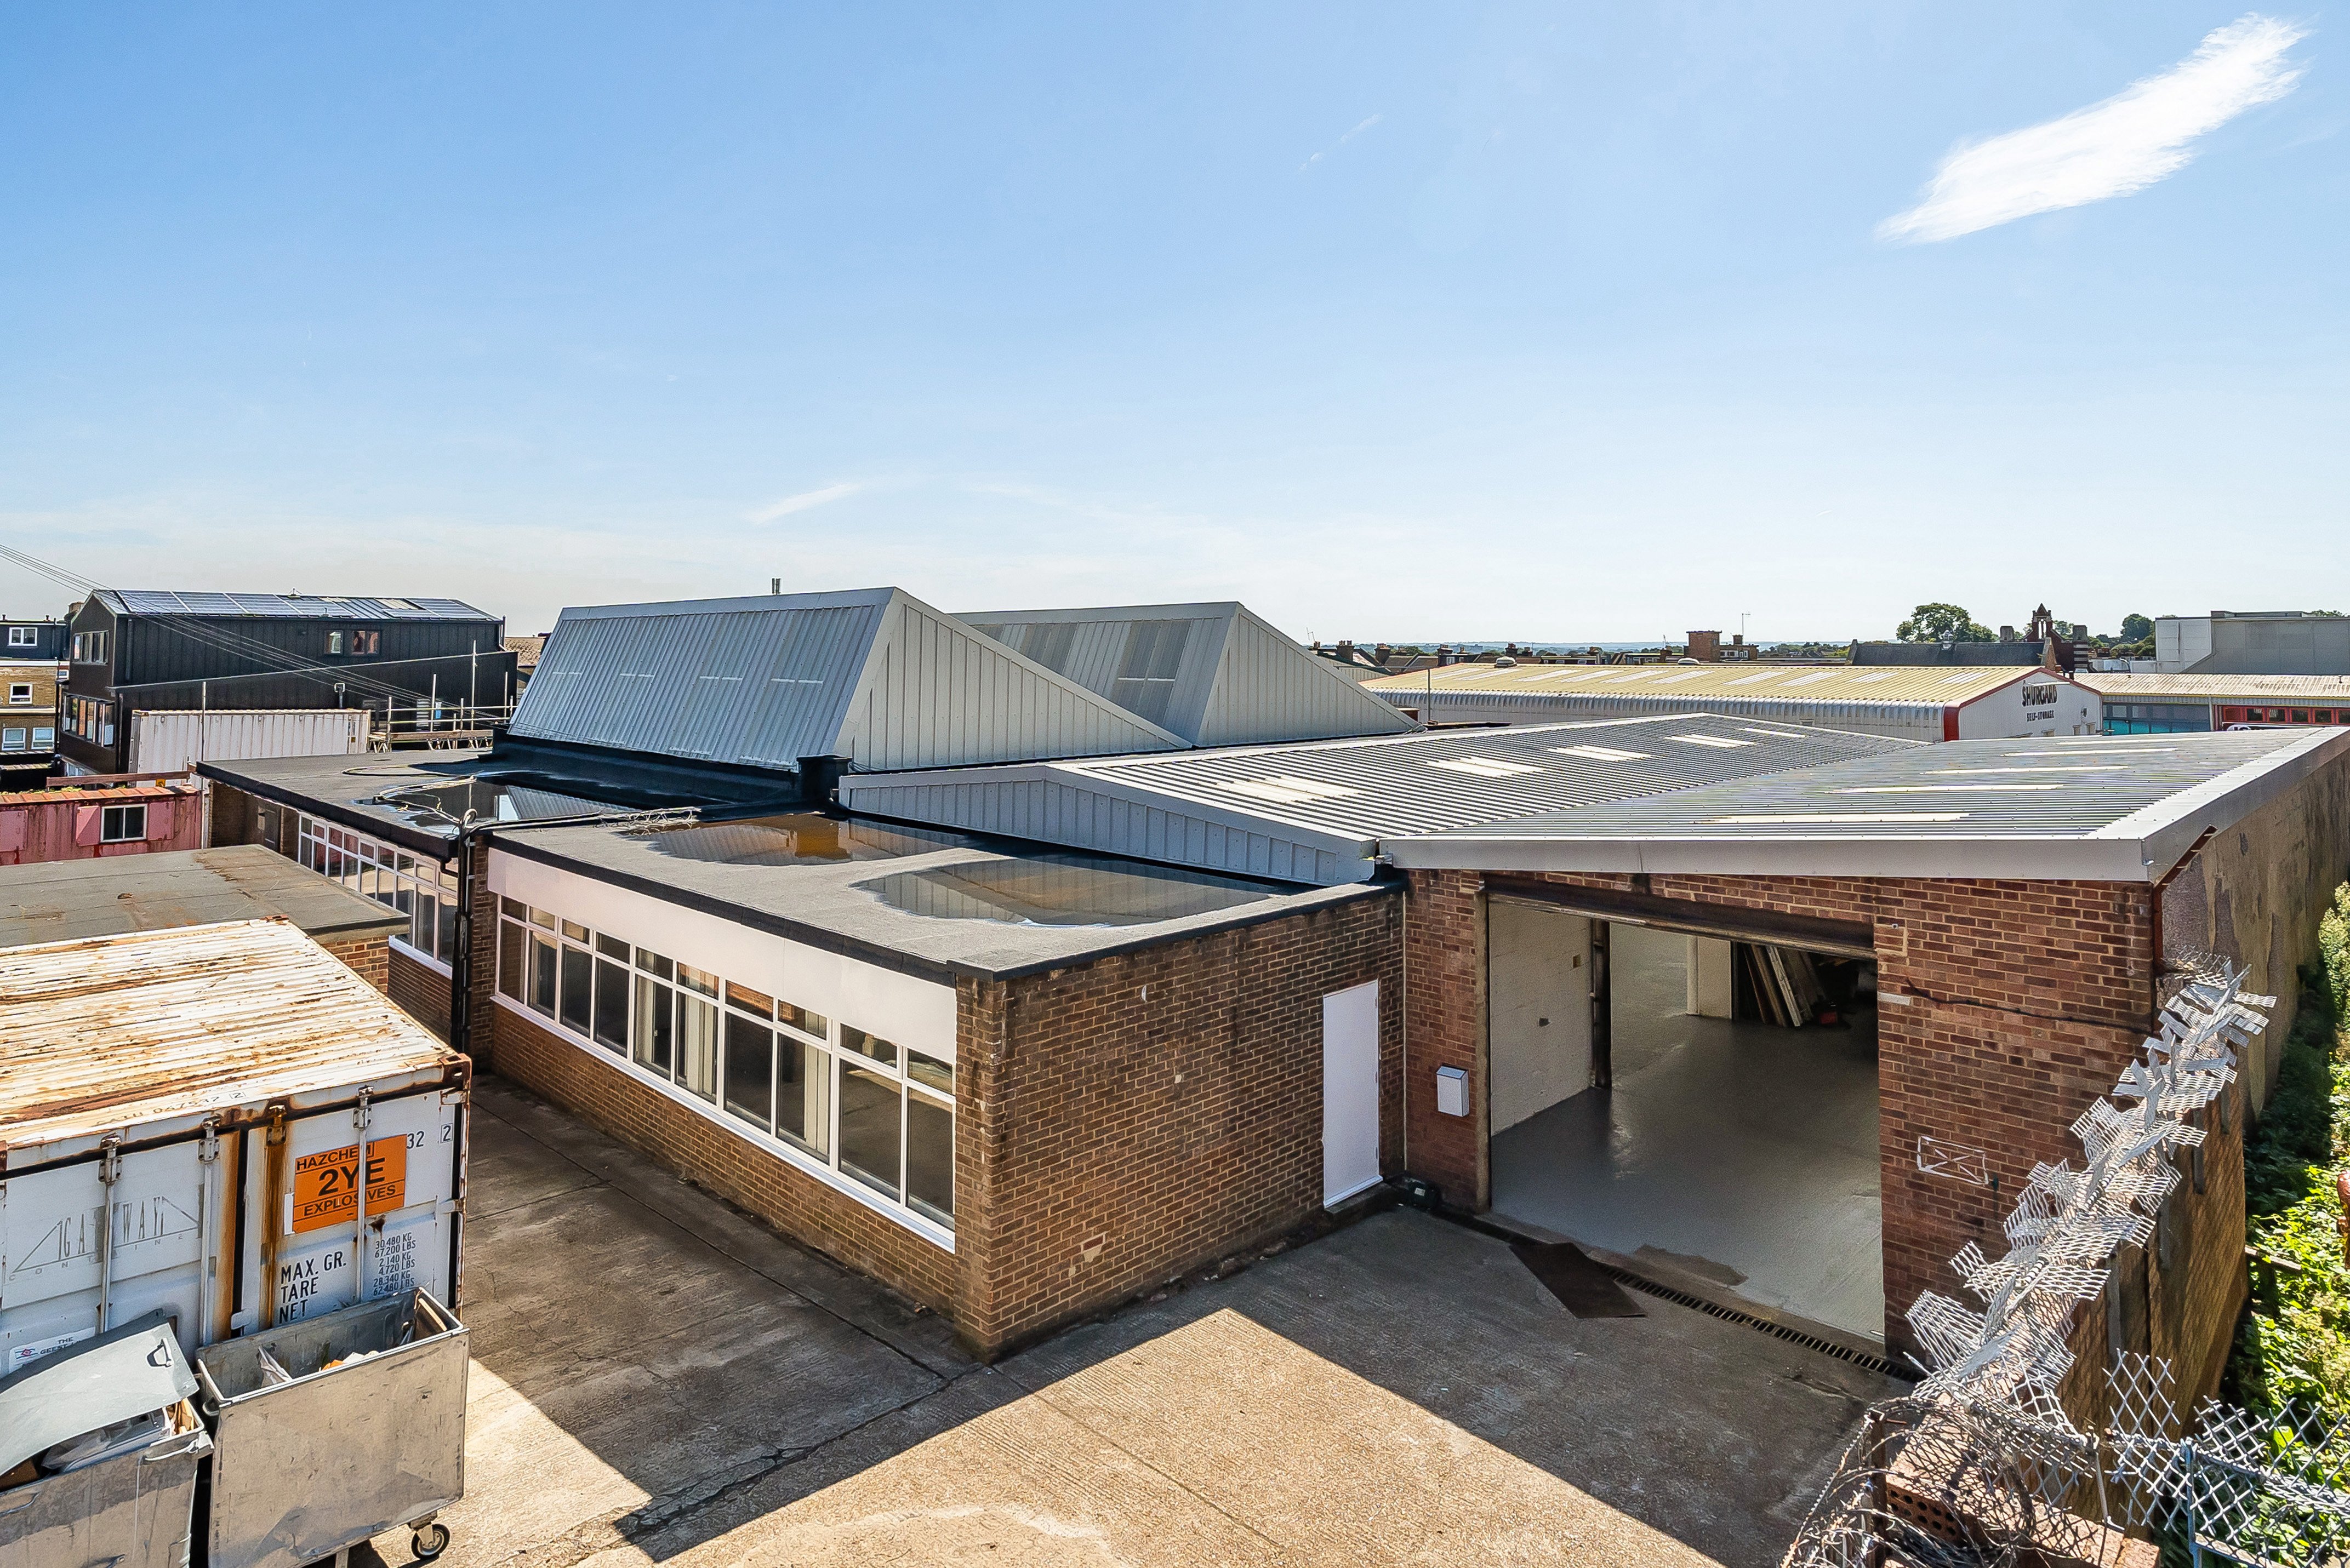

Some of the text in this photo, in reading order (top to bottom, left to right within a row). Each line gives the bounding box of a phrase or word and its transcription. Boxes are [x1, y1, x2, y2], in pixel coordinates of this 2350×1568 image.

[2022, 685, 2057, 707] SHURGARD
[407, 1131, 425, 1149] 32
[318, 1157, 385, 1197] 2YE
[304, 1184, 396, 1216] EXPLOVES
[64, 1196, 161, 1258] GAWAY
[403, 1232, 412, 1243] KG
[403, 1240, 416, 1251] LBS
[402, 1251, 411, 1261] KG
[402, 1259, 415, 1271] LBS
[281, 1251, 346, 1284] MAX. GR.
[401, 1271, 410, 1281] KG
[281, 1277, 319, 1303] TARE
[400, 1278, 414, 1290] LBS
[279, 1299, 308, 1324] NET
[40, 1344, 69, 1355] GEEST
